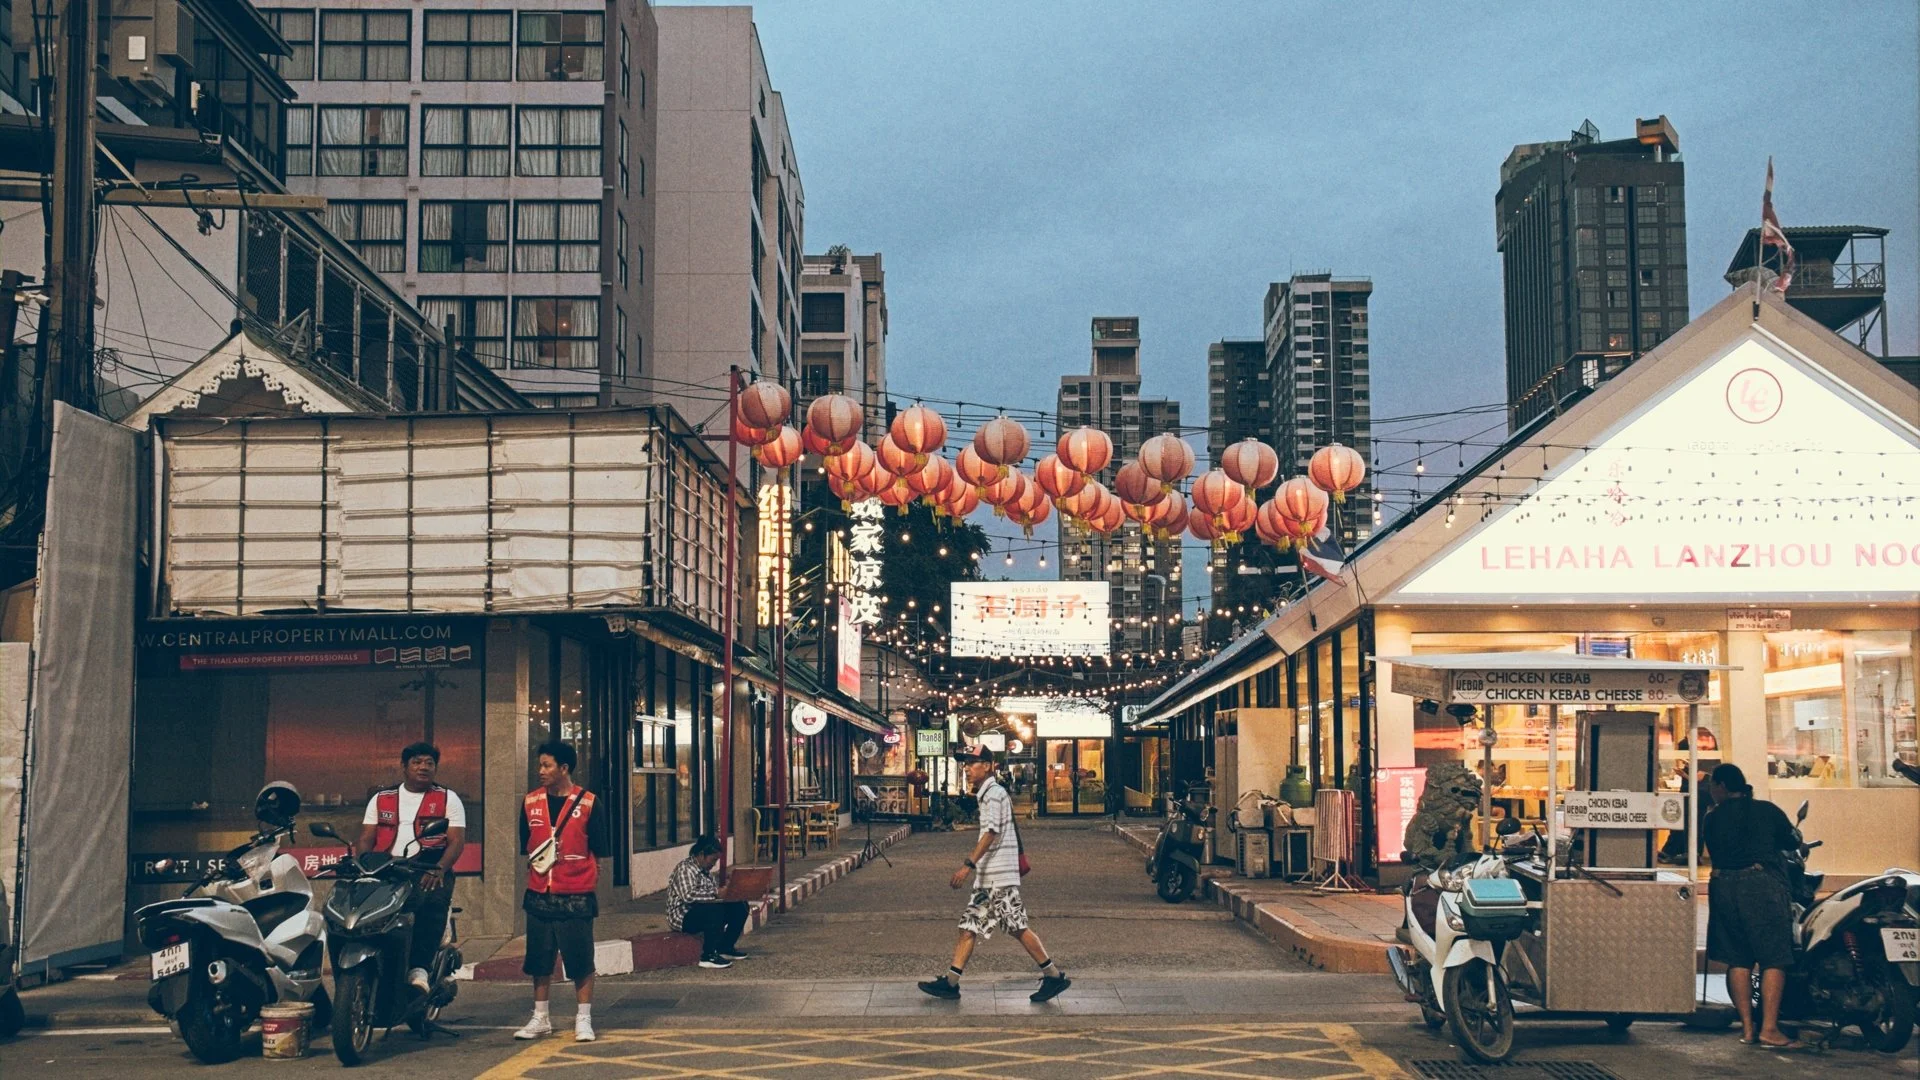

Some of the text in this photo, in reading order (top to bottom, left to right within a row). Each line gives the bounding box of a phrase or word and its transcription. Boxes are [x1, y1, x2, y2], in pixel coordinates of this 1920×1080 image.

[1481, 545, 1633, 570] LEHAHA
[1653, 543, 1832, 569] LANZHOU
[972, 593, 1088, 620] 歪厨子
[192, 653, 359, 665] THE THAILAND PROPERTY PROFESSIONALS
[1485, 671, 1674, 685] CHICKEN KEBAB 60.-
[1485, 688, 1673, 701] CHICKEN KEBAB CHEESE 80.-
[918, 732, 942, 742] Than88
[1588, 798, 1628, 808] CHICKEN KEBAB
[1588, 812, 1647, 822] CHICKEN KEBAB CHEESE
[303, 854, 346, 871] 房地
[157, 962, 185, 977] 5449
